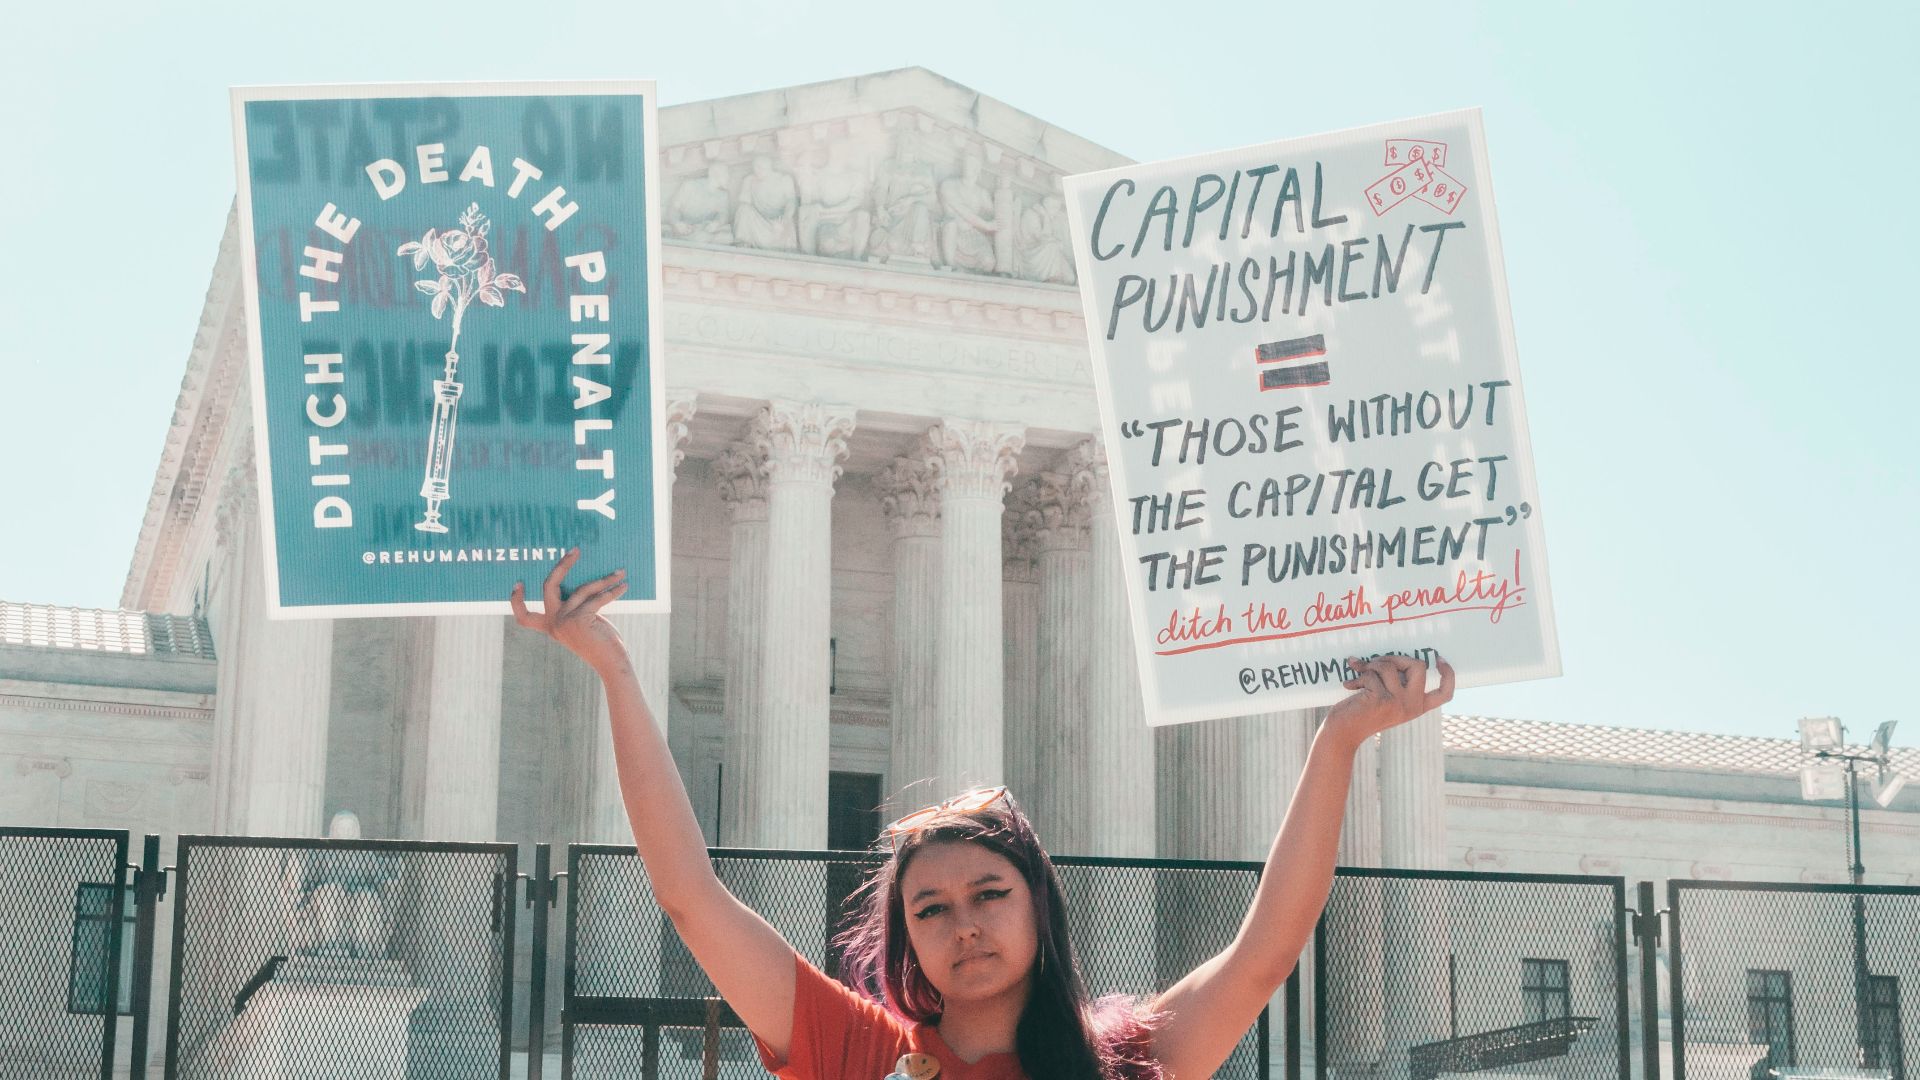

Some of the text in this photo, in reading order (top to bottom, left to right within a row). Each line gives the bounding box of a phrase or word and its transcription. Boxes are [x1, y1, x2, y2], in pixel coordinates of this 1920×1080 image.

[1091, 161, 1348, 261] CAPITAL
[1106, 221, 1466, 340] PUNISHMENT
[299, 142, 616, 529] DITCH THE DEATH PENALTY
[679, 312, 1090, 378] EQUAL JUSTICE UNDER LA
[1256, 333, 1331, 392] =
[1328, 380, 1511, 443] WITHOUT
[1129, 454, 1508, 535] THE CAPITAL GET
[1139, 544, 1228, 592] THE
[1156, 548, 1527, 645] ditch the death penalty!
[1238, 647, 1440, 695] @REHUMAT
